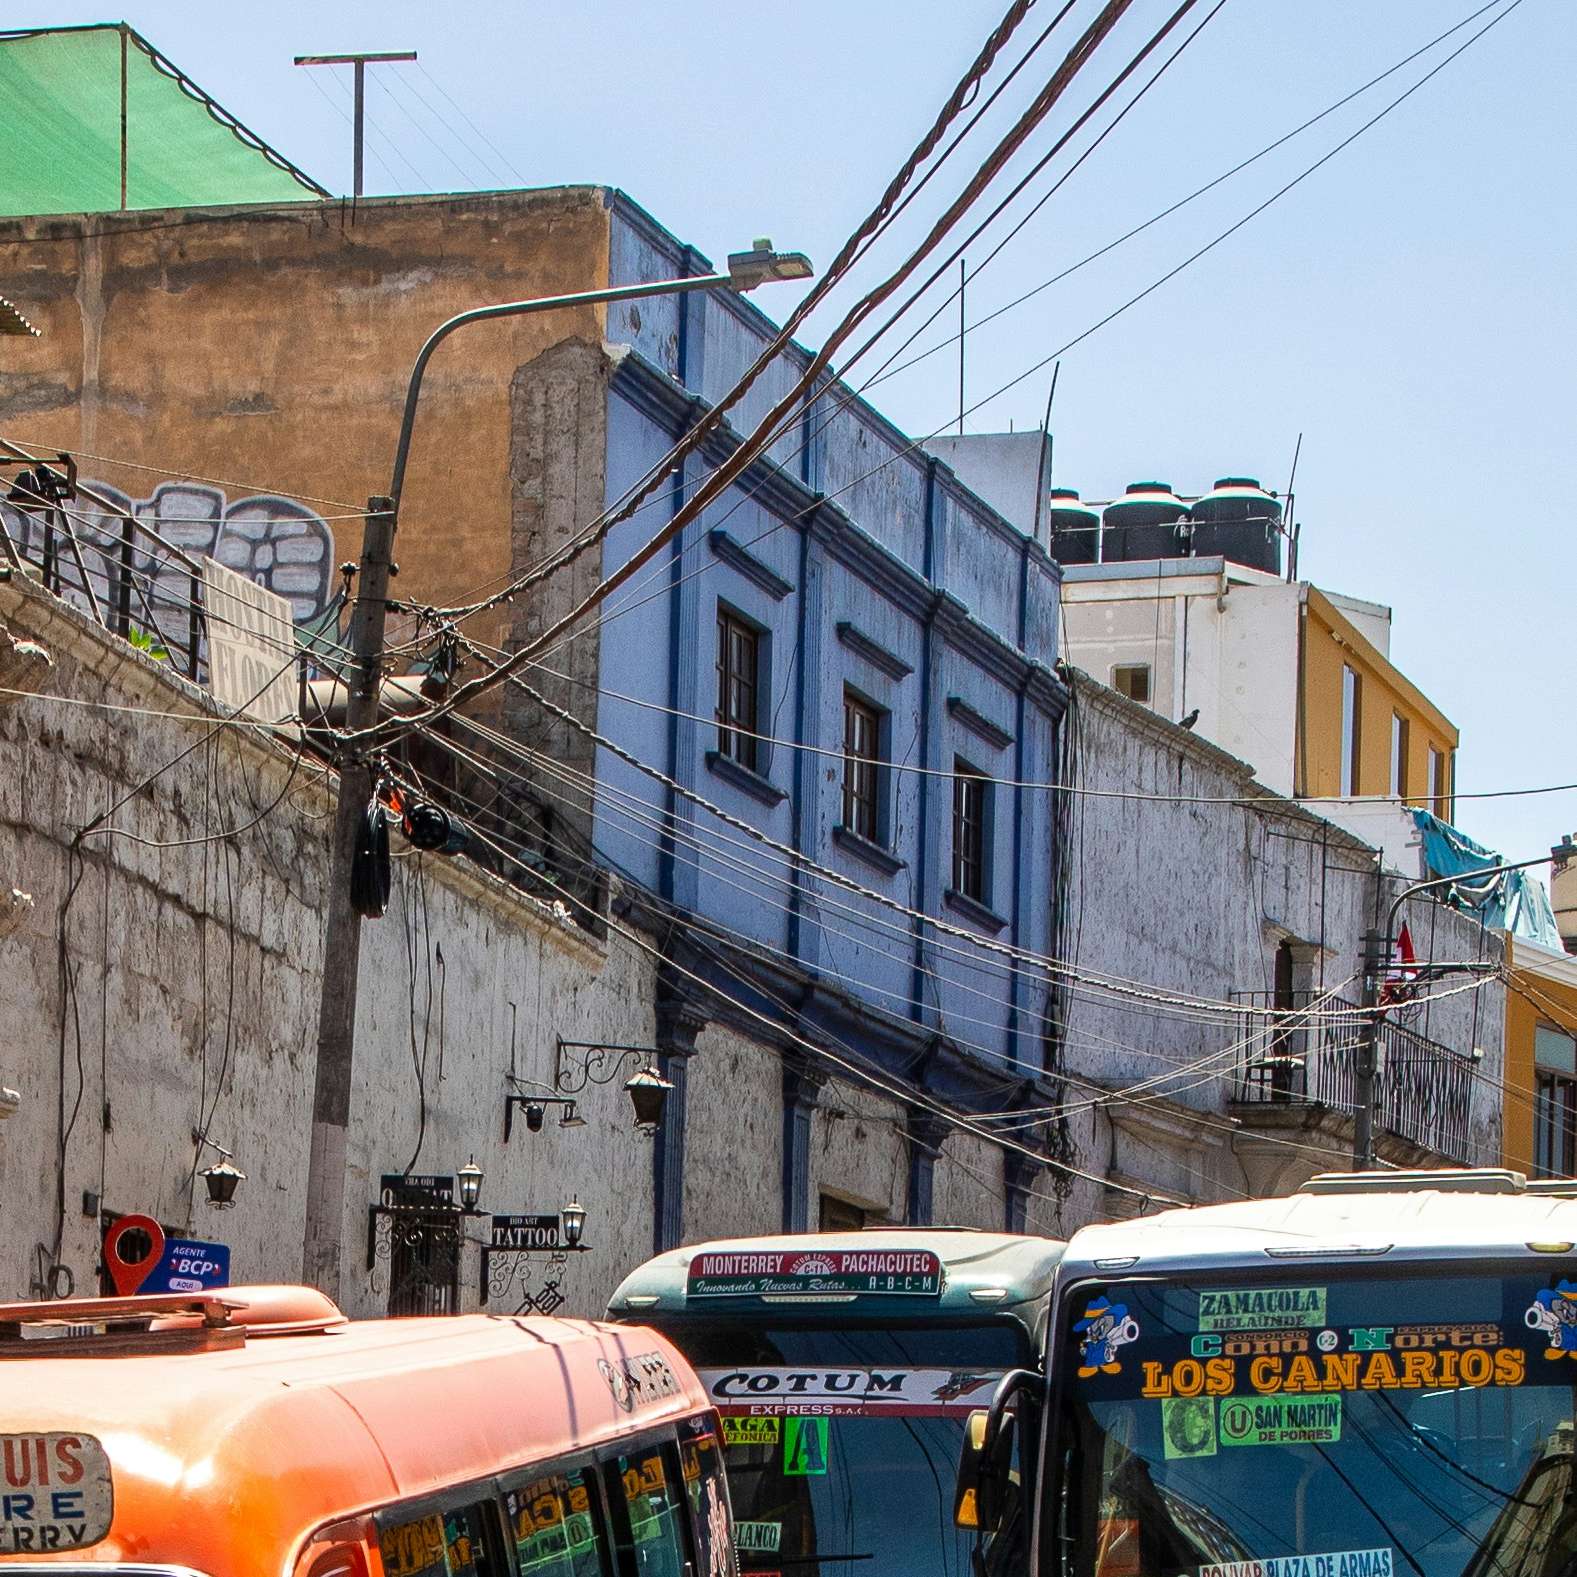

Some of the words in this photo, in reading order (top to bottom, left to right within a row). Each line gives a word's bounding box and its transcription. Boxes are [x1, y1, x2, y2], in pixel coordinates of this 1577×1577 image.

[493, 1227, 558, 1247] TATTOO
[173, 1246, 206, 1257] AGENTE
[178, 1259, 213, 1275] BCP
[702, 1256, 783, 1274] MONTERREY
[841, 1254, 930, 1273] PACHACUTEC
[696, 1280, 755, 1293] Innovando
[759, 1279, 803, 1291] Nuevas
[1201, 1290, 1319, 1317] ZAMACOLA
[1225, 1331, 1309, 1341] CONSORCIO
[1142, 1358, 1235, 1398] LOS
[1250, 1347, 1525, 1394] CANARIOS
[712, 1373, 907, 1401] COTUM
[750, 1405, 834, 1415] EXPRESS
[1255, 1405, 1283, 1429] SAN
[1286, 1397, 1338, 1427] MARTÍN
[723, 1418, 777, 1431] AGA
[1230, 1410, 1247, 1433] U
[725, 1432, 777, 1441] EFONICA
[1258, 1431, 1276, 1442] DE
[1280, 1429, 1333, 1441] PORRES
[787, 1419, 825, 1471] A
